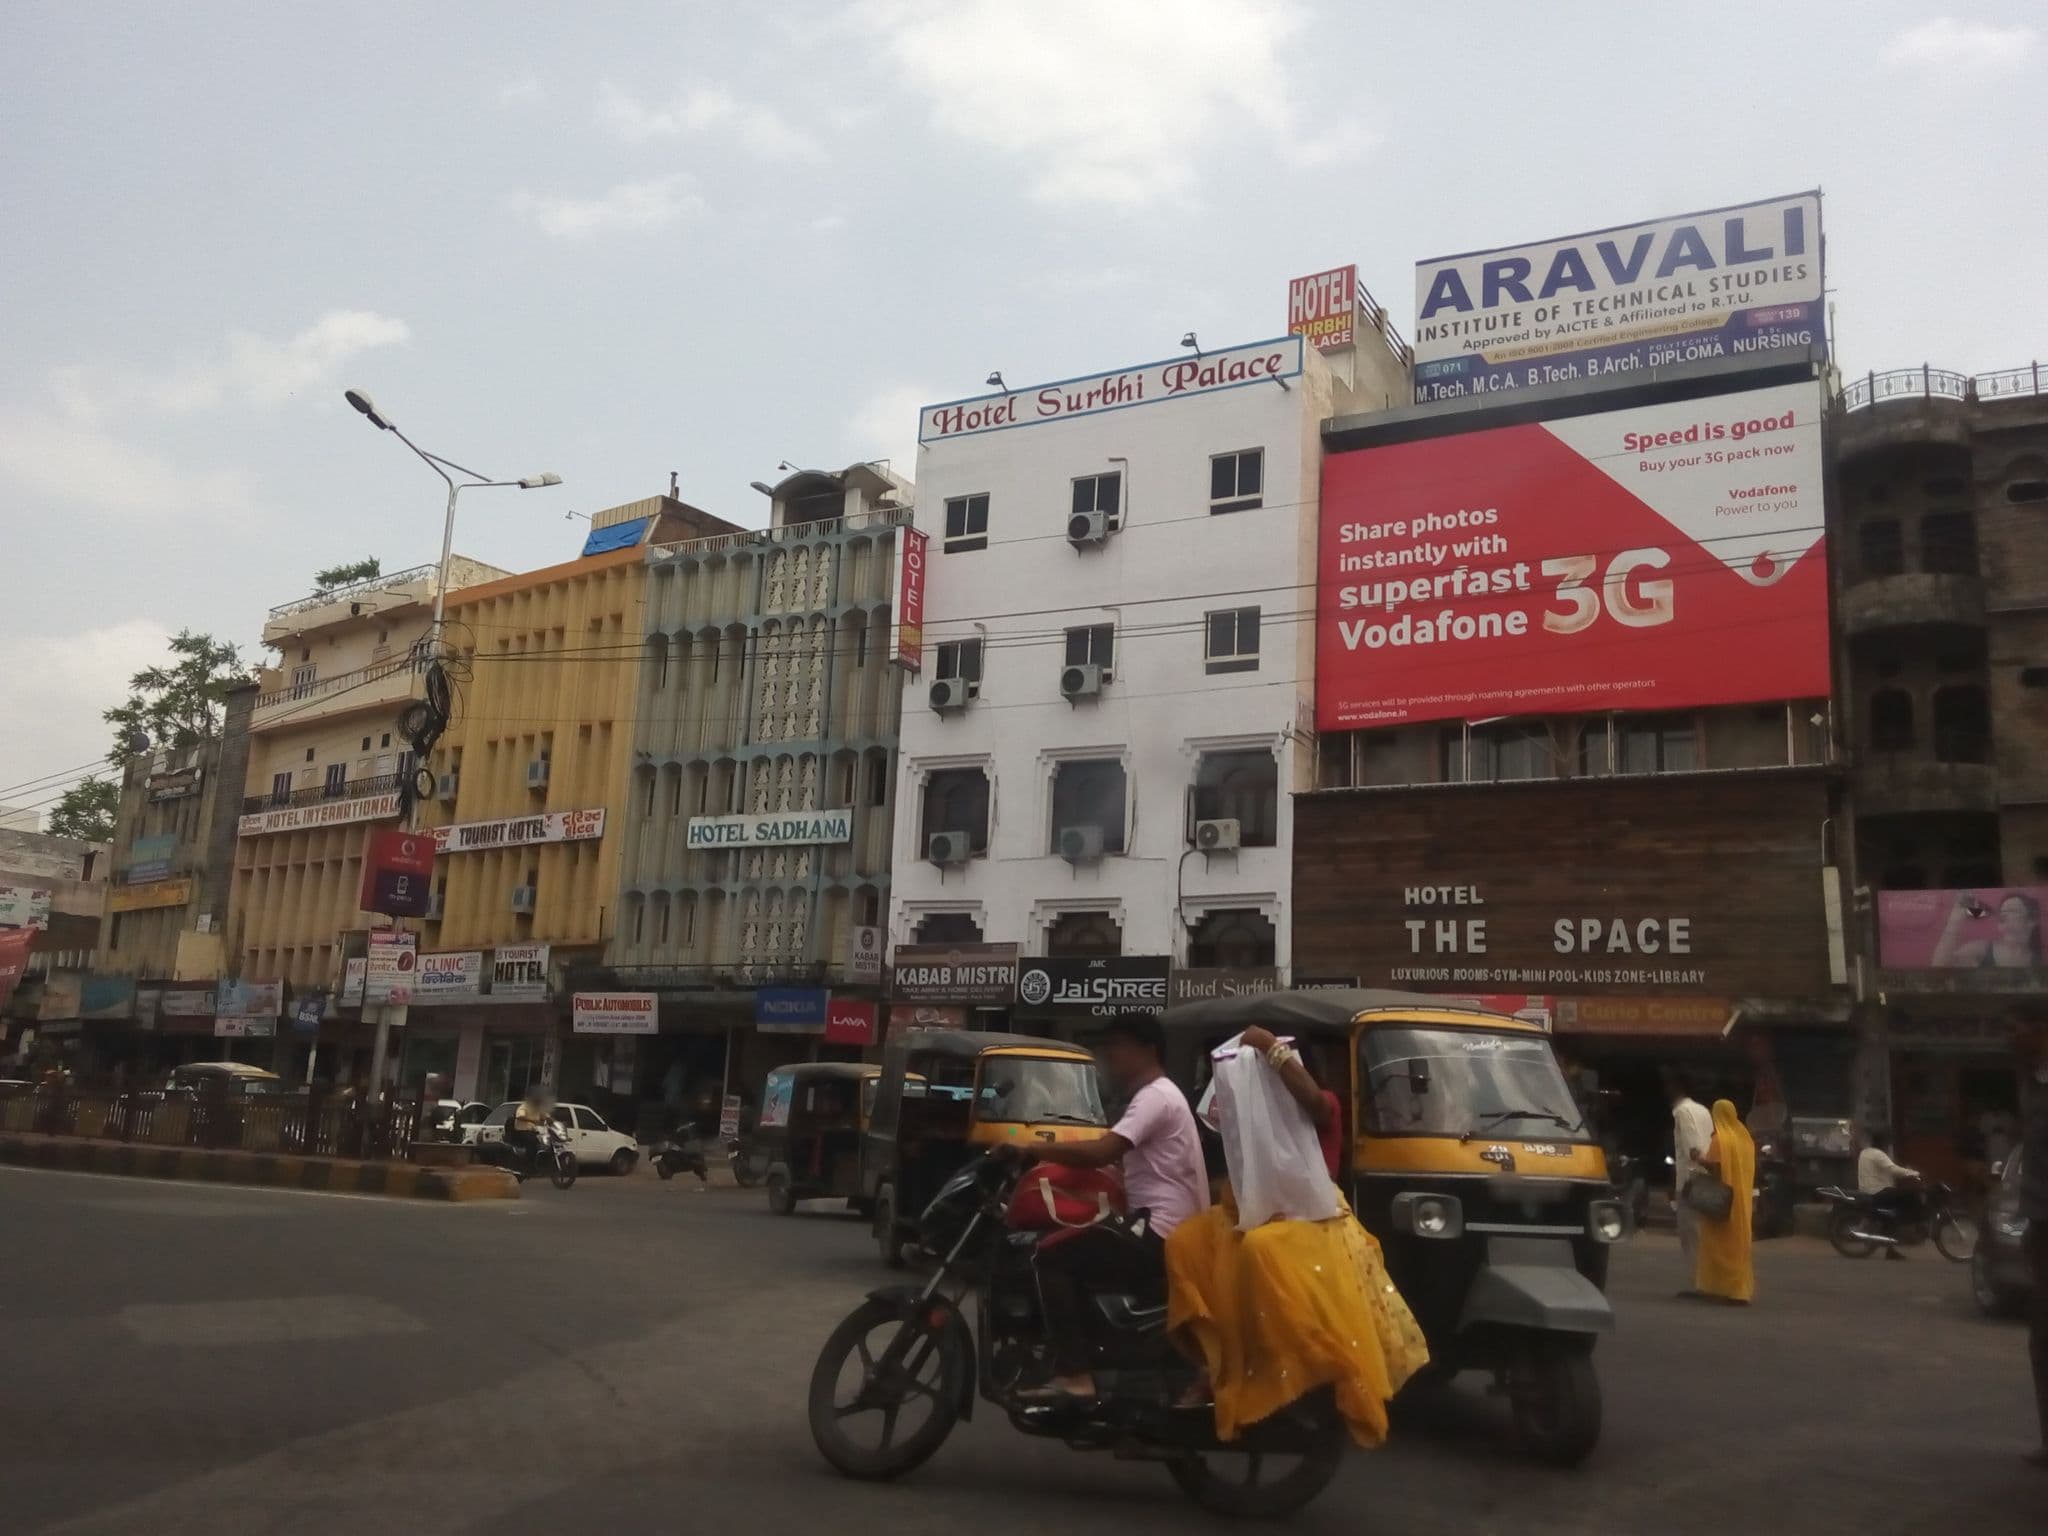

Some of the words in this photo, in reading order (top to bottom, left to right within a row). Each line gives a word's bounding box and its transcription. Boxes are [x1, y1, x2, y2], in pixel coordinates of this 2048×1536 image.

[1419, 206, 1805, 320] ARAVALI
[1290, 270, 1352, 324] HOTEL
[1416, 312, 1522, 343] INSTITUTE
[1534, 305, 1560, 322] OF
[1572, 282, 1697, 317] TECHNICAL
[1709, 264, 1808, 293] STUDIES
[1292, 314, 1352, 336] SURBHI
[1462, 330, 1530, 351] Approved
[1535, 328, 1551, 340] by
[1556, 319, 1598, 335] AICTE
[1603, 316, 1614, 327] &
[1620, 303, 1686, 324] Affiliated
[1692, 302, 1705, 311] to
[1712, 293, 1753, 308] R.T.U.
[1779, 309, 1800, 321] 139
[1577, 334, 1617, 348] Certified
[1621, 323, 1679, 340] Engineering
[1682, 316, 1720, 330] College
[1650, 335, 1720, 351] POLYTECHNIC
[1416, 380, 1468, 402] M.Tech.
[1473, 372, 1519, 394] M.C.A.
[1528, 362, 1582, 385] B.Tech.
[1588, 352, 1644, 376] B.Arch.
[1649, 342, 1724, 367] DIPLOMA
[1733, 330, 1812, 354] NURSING
[1442, 362, 1461, 374] 071
[933, 396, 1017, 434] Hotel
[1037, 374, 1144, 416] Surbhi
[1162, 353, 1283, 396] Palace
[1623, 424, 1698, 453] Speed
[1704, 422, 1725, 440] is
[1731, 410, 1795, 440] good
[1639, 460, 1666, 472] Buy
[1669, 456, 1701, 471] your
[1705, 451, 1723, 464] 3G
[1727, 447, 1760, 463] pack
[1764, 444, 1795, 457] now
[1728, 484, 1797, 499] Vodafone
[1715, 504, 1753, 516] Power
[1757, 501, 1771, 512] to
[1774, 499, 1798, 513] you
[1339, 521, 1406, 543] Share
[1412, 508, 1498, 538] photos
[1339, 542, 1448, 572] instantly
[1452, 534, 1508, 558] with
[907, 533, 921, 624] HOTEL
[1339, 562, 1530, 613] superfast
[1541, 547, 1674, 634] 3G
[1338, 609, 1528, 651] Vodafone
[1397, 697, 1407, 706] be
[1408, 694, 1443, 707] provided
[1445, 692, 1478, 703] through
[1479, 688, 1513, 700] roaming
[1514, 684, 1566, 698] agreements
[1567, 683, 1585, 693] with
[1587, 681, 1611, 692] other
[1613, 679, 1656, 691] operators
[1337, 709, 1408, 721] www.vodafone.in
[265, 813, 300, 829] HOTEL
[302, 795, 398, 825] INTERNATIONAL
[459, 822, 507, 847] TOURIST
[508, 818, 547, 842] HOTEL
[689, 823, 749, 844] HOTEL
[755, 818, 848, 841] SADHANA
[1404, 885, 1484, 905] HOTEL
[1404, 919, 1488, 954] THE
[1553, 918, 1692, 954] SPACE
[425, 957, 464, 972] CLINIC
[503, 949, 540, 960] TOURIST
[854, 951, 879, 961] KABAB
[494, 961, 546, 984] HOTEL
[895, 967, 951, 985] KABAB
[956, 966, 1015, 985] MISTRI
[1391, 967, 1450, 981] LUXURIOUS
[1175, 978, 1217, 998] Hotel
[1222, 977, 1274, 999] Surbhi
[575, 997, 602, 1011] PUBLIC
[602, 997, 652, 1012] AUTOMOBILES
[763, 1001, 817, 1013] NOKIA
[1091, 1005, 1117, 1016] CAR
[299, 1012, 319, 1024] BSNL
[832, 1016, 868, 1028] LAVA
